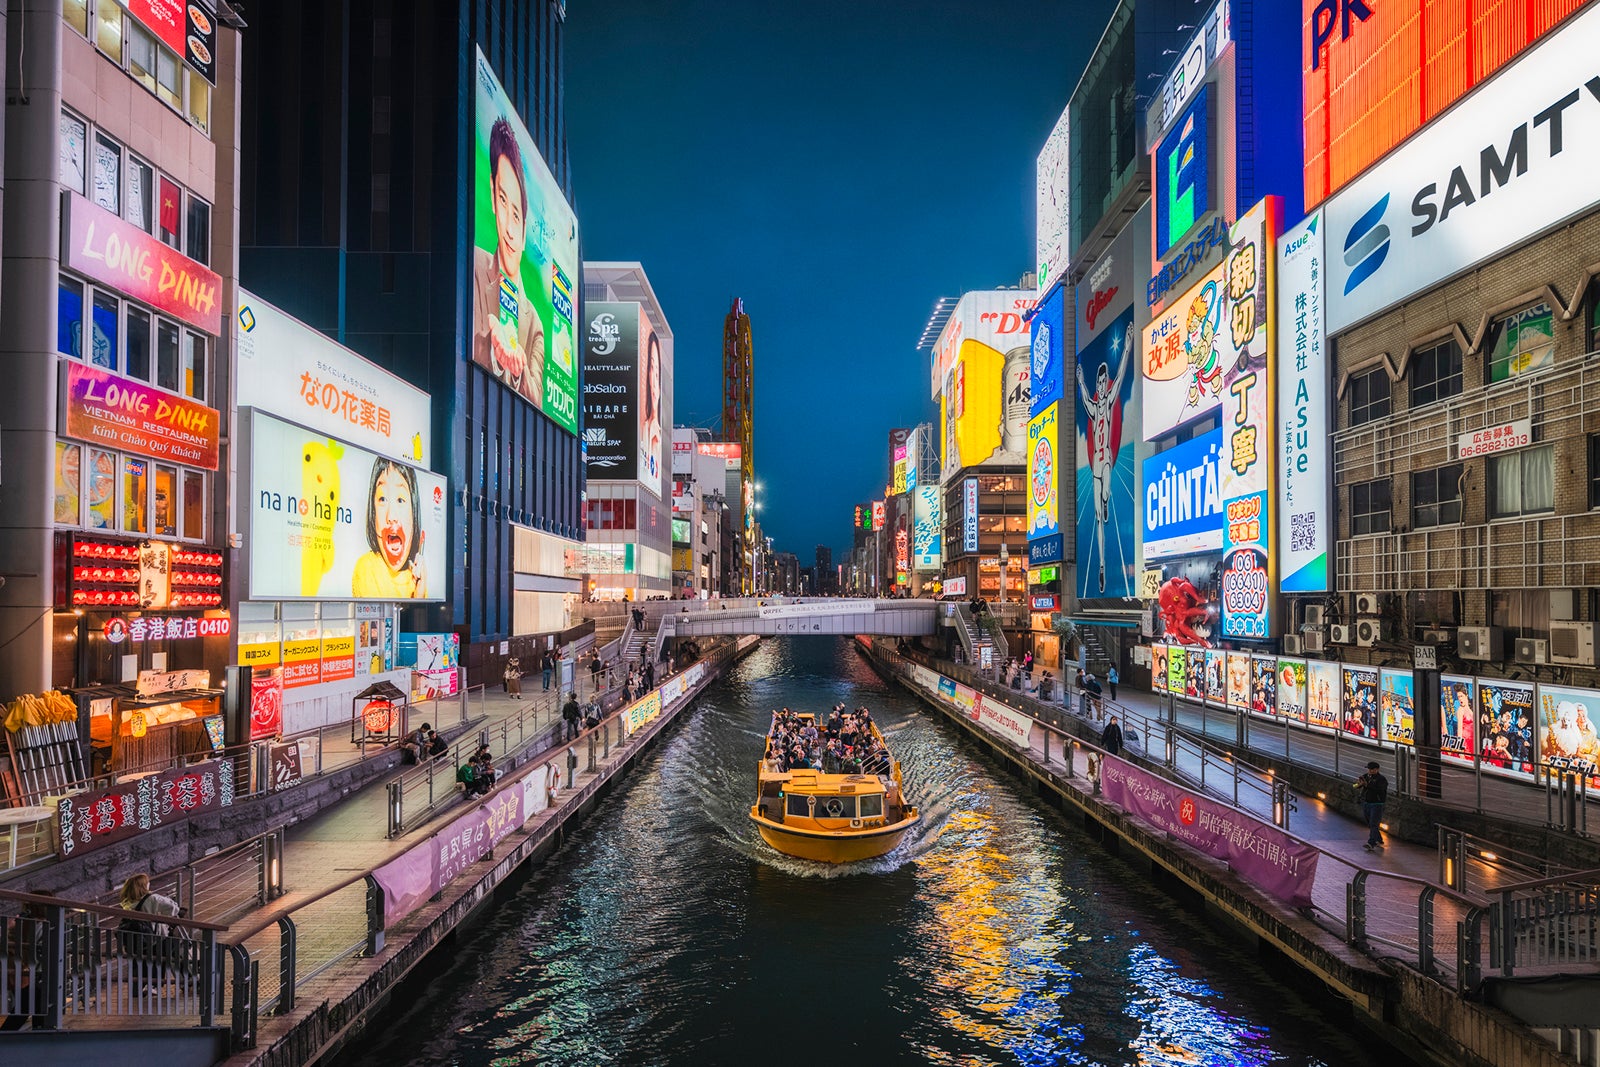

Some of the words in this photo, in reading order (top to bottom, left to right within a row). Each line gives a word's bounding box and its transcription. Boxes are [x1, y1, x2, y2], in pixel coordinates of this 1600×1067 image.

[1284, 232, 1308, 258] Asue
[81, 219, 153, 286] LONG
[158, 259, 215, 316] DINH
[1086, 286, 1119, 331] Glico
[1310, 256, 1320, 356] 丸善インテックは、
[590, 320, 619, 338] Spa
[1151, 314, 1178, 346] かぜに
[1295, 292, 1308, 372] 株式会社
[1148, 329, 1182, 376] 改源
[83, 378, 151, 417] LONG
[154, 398, 209, 433] DINH
[300, 370, 391, 437] なの花薬局
[83, 404, 136, 427] VIETNAM
[142, 421, 208, 447] RESTAURANT
[92, 424, 118, 441] Kính
[120, 431, 147, 447] Chào
[149, 439, 169, 453] Quý
[1295, 378, 1309, 473] Asue
[1472, 424, 1514, 445] 広告募集
[1460, 434, 1528, 458] 06-6262-1313
[1285, 421, 1294, 507] に変わりました。
[1227, 496, 1261, 521] ひまわり
[1229, 520, 1260, 543] 不動産
[1235, 554, 1252, 571] 06
[1229, 591, 1260, 610] 6304
[129, 617, 198, 642] 香港飯店
[200, 619, 229, 635] 0410
[1226, 617, 1265, 636] 年中無休
[245, 649, 271, 659] 韓国コスメ
[284, 645, 319, 656] オーガニックコスメ
[325, 643, 351, 652] ブランドコスメ
[1415, 647, 1435, 658] BAR
[161, 781, 176, 815] ラーメン
[176, 777, 197, 809] 定食
[219, 760, 233, 807] 大衆食堂
[1126, 775, 1175, 812] 新たな時代へ
[76, 806, 94, 843] 天ぷら
[96, 799, 116, 831] 焼鳥
[1182, 800, 1193, 822] 祝
[440, 822, 485, 870] 鳥取県は
